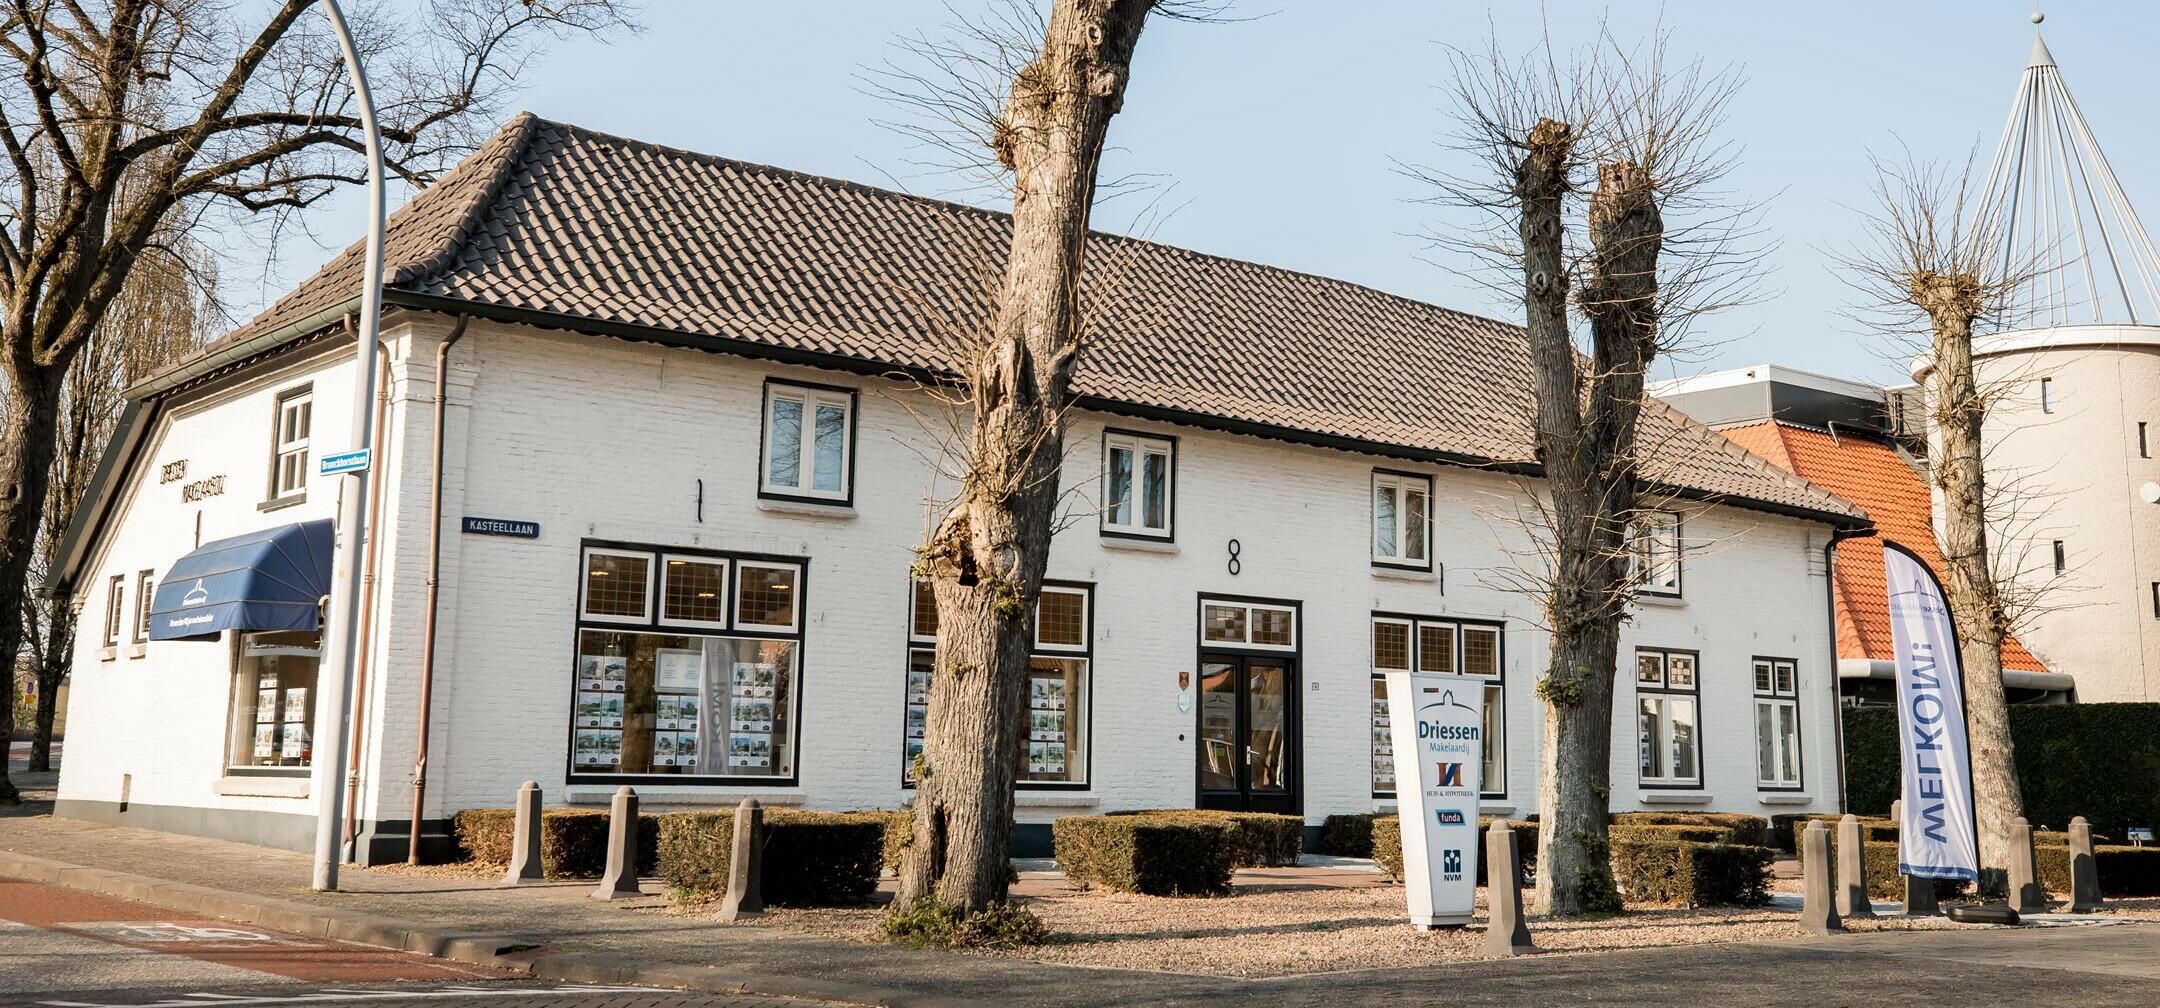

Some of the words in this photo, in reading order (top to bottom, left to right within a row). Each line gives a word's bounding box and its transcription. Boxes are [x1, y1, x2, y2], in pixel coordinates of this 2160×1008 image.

[469, 519, 534, 535] KASTEELLAAN
[1418, 720, 1479, 740] Driessen
[1429, 742, 1470, 755] Makelaardij
[1441, 812, 1461, 822] funda
